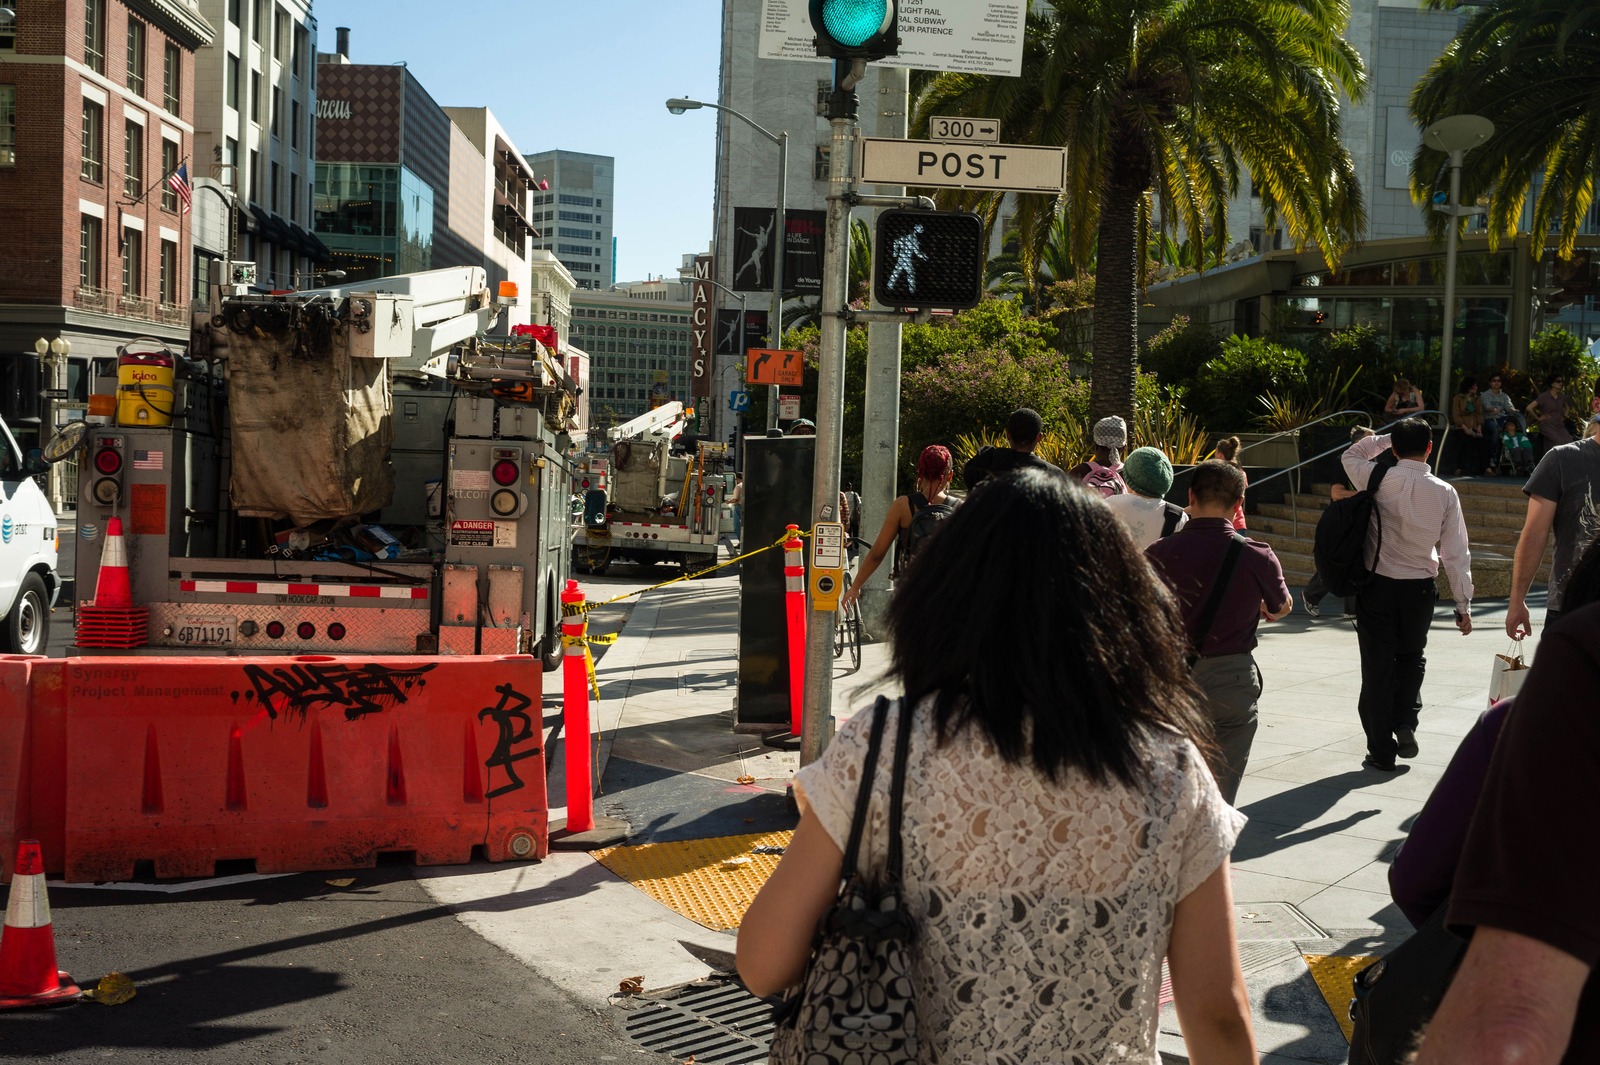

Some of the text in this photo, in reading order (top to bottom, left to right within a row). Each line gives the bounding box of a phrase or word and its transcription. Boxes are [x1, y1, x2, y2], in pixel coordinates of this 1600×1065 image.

[899, 7, 942, 16] LIGHT RAIL
[898, 15, 947, 26] RAL SUBWAY
[916, 26, 954, 35] PATIENCE
[316, 99, 353, 120] arcus
[938, 121, 974, 138] 300
[917, 151, 1007, 180] POST
[804, 277, 821, 285] Young
[132, 370, 158, 382] igloo
[463, 521, 493, 530] DANGER
[275, 594, 288, 603] TOW
[288, 594, 305, 604] HOOK
[320, 596, 336, 605] 2TON
[187, 616, 225, 627] California
[178, 627, 232, 643] 6B71191
[73, 667, 140, 682] Synergy
[72, 684, 224, 700] Project Management
